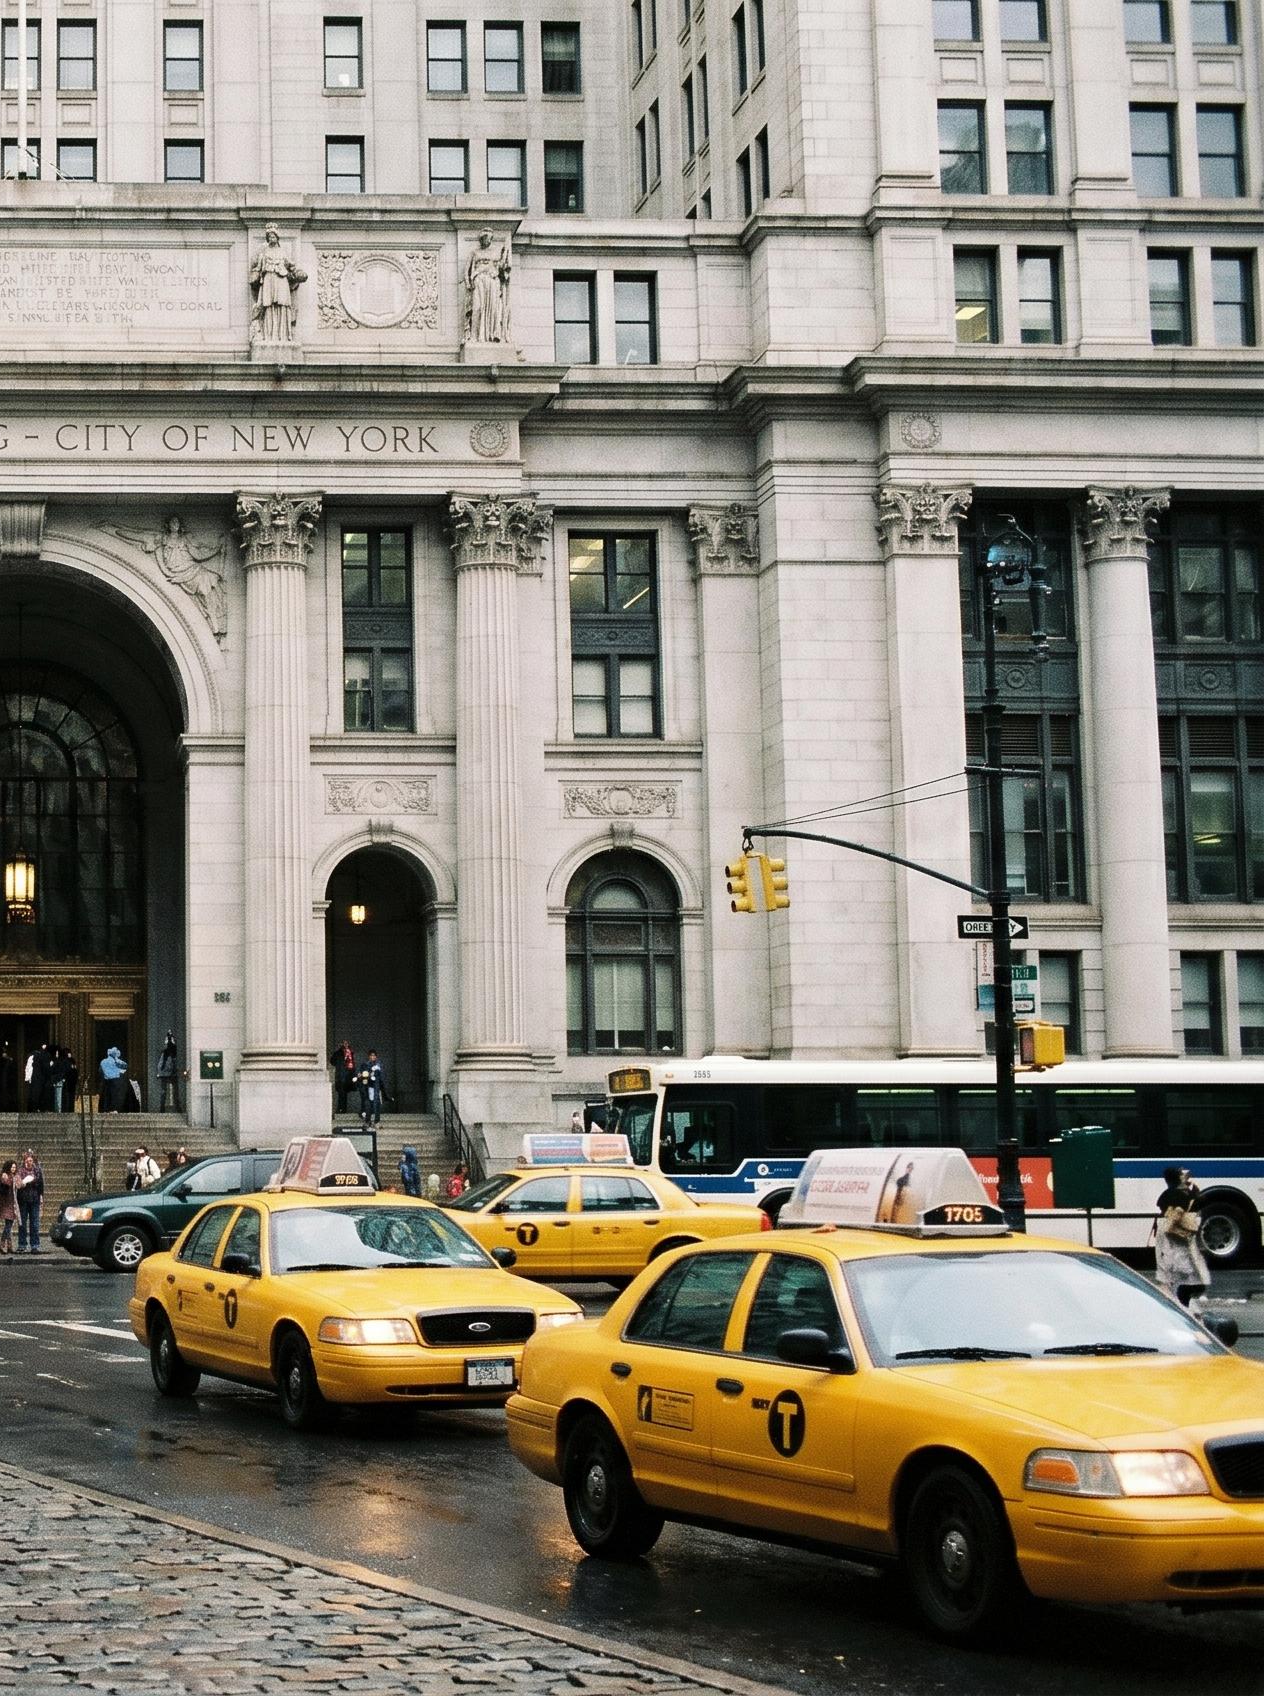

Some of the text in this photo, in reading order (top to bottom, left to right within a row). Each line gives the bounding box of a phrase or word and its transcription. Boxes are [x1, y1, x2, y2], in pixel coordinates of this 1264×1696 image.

[56, 424, 141, 451] CITY
[162, 424, 209, 451] OF
[231, 425, 315, 452] NEW
[336, 426, 439, 453] YORK
[944, 1206, 983, 1223] 1705
[777, 1401, 798, 1449] T
